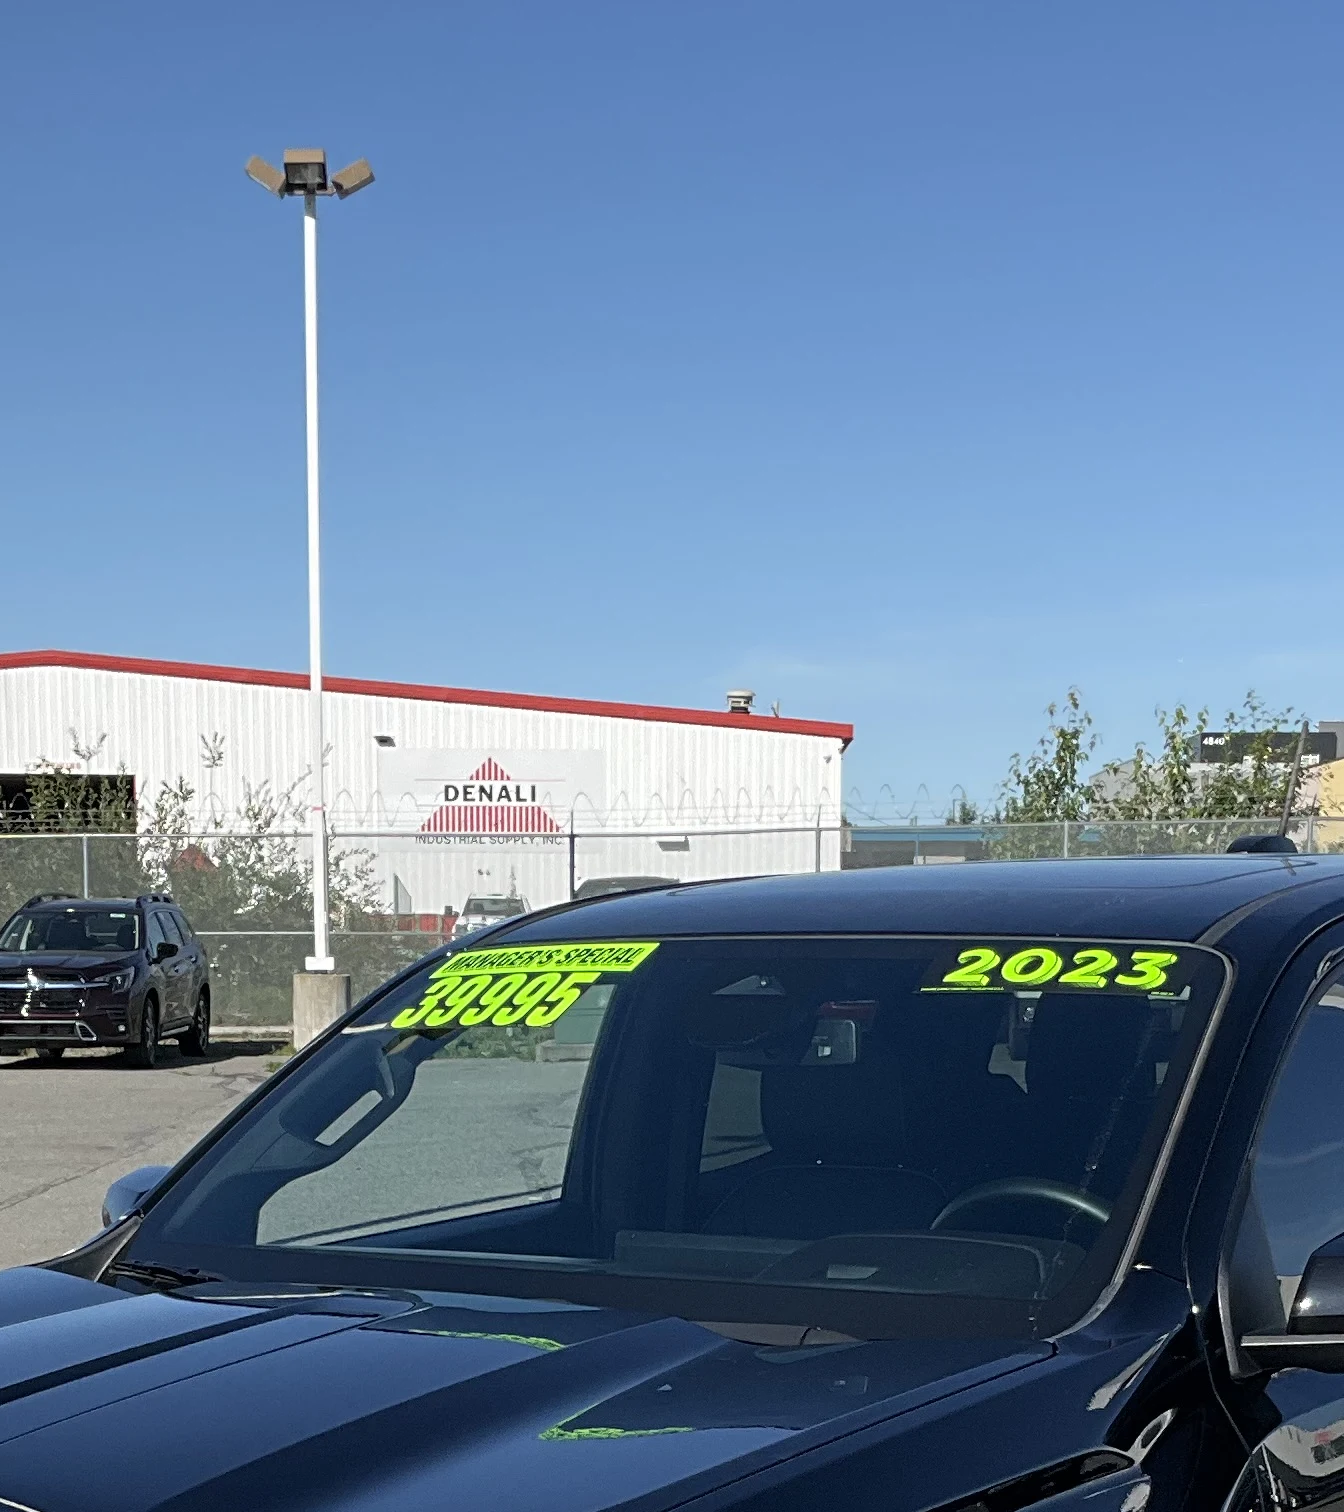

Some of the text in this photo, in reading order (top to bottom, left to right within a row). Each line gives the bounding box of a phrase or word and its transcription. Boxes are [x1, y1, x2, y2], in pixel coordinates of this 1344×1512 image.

[1202, 737, 1225, 745] 4840
[444, 784, 537, 803] DENALI
[415, 835, 486, 845] INDUSTRIAL
[443, 947, 646, 973] MANAGER'S SPECIAL
[942, 948, 1178, 989] 2023
[390, 972, 602, 1028] 39995
